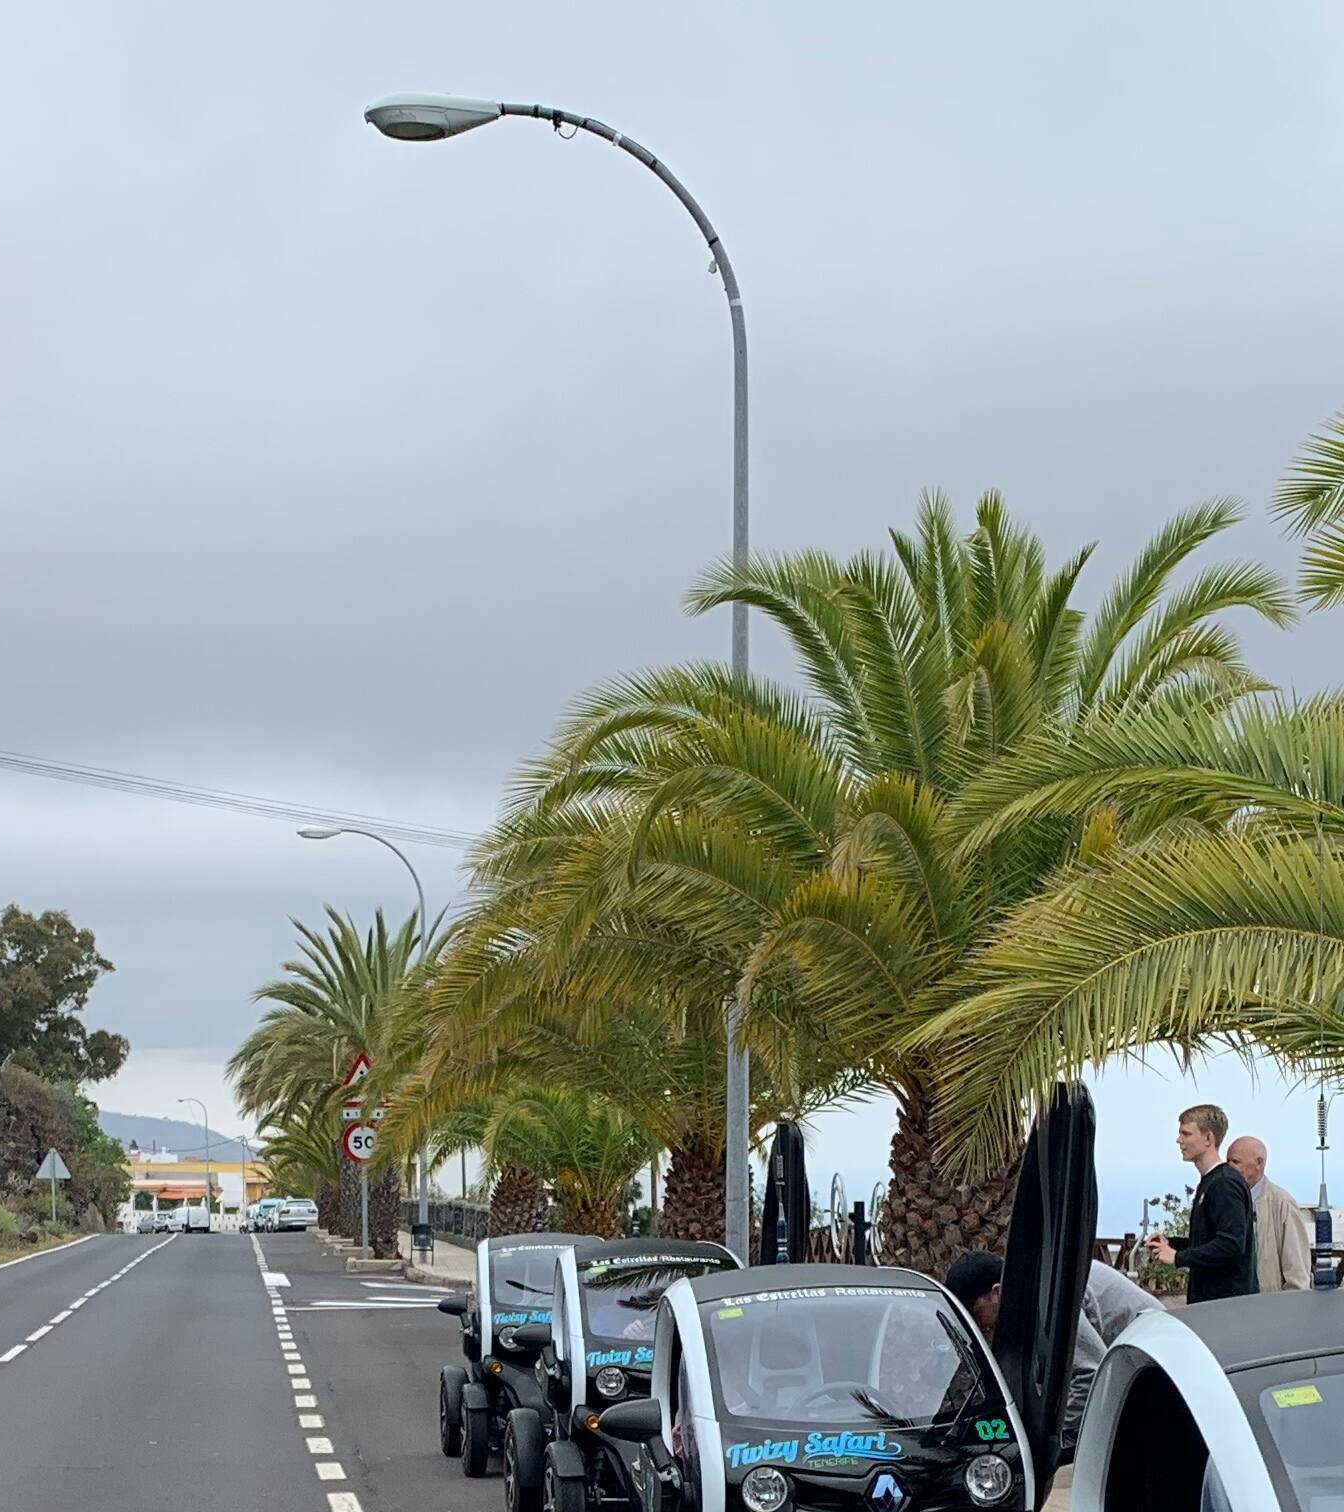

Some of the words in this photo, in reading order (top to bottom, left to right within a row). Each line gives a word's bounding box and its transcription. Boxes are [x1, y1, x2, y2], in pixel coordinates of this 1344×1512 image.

[353, 1136, 374, 1149] 50
[721, 1296, 751, 1307] Las
[756, 1287, 826, 1302] Estrellas
[834, 1287, 927, 1299] Restaurante
[586, 1349, 631, 1367] Twizy
[975, 1419, 1009, 1440] 02
[726, 1439, 799, 1468] Twizy
[805, 1431, 886, 1455] Safari
[807, 1458, 858, 1468] TENERIFE
